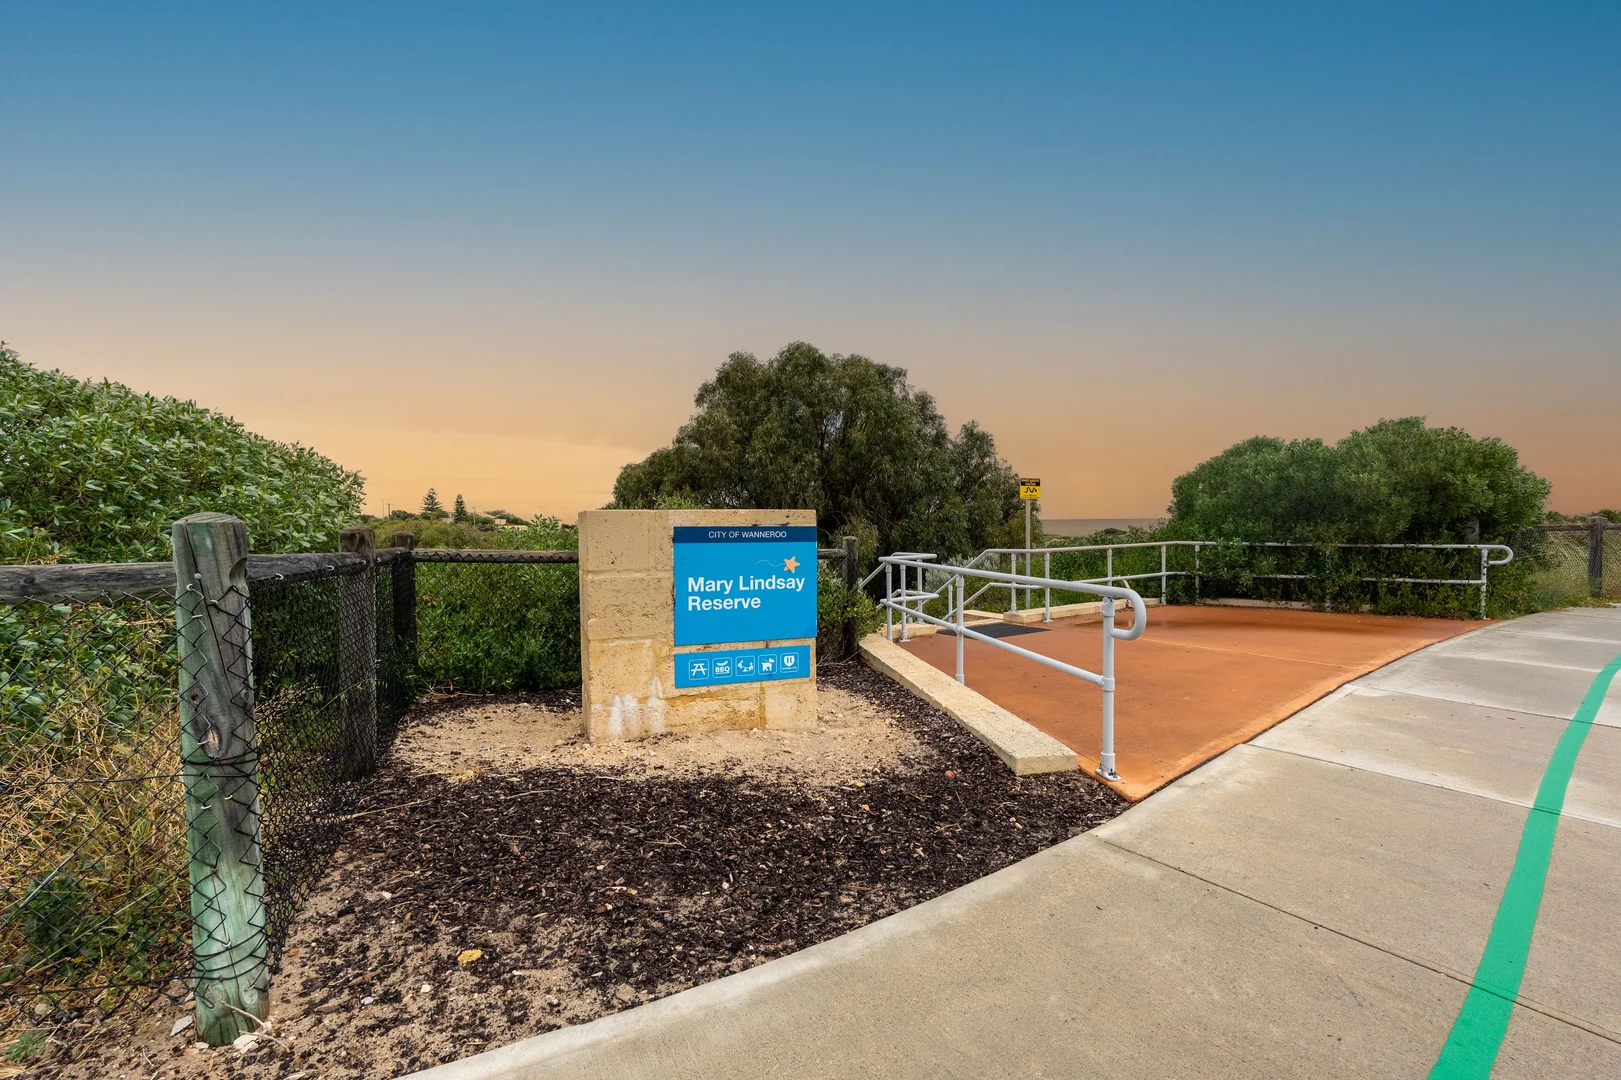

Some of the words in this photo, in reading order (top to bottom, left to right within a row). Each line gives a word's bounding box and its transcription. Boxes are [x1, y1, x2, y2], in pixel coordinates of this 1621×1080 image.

[688, 577, 733, 594] Mary
[739, 575, 805, 592] Lindsay
[688, 596, 761, 611] Reserve
